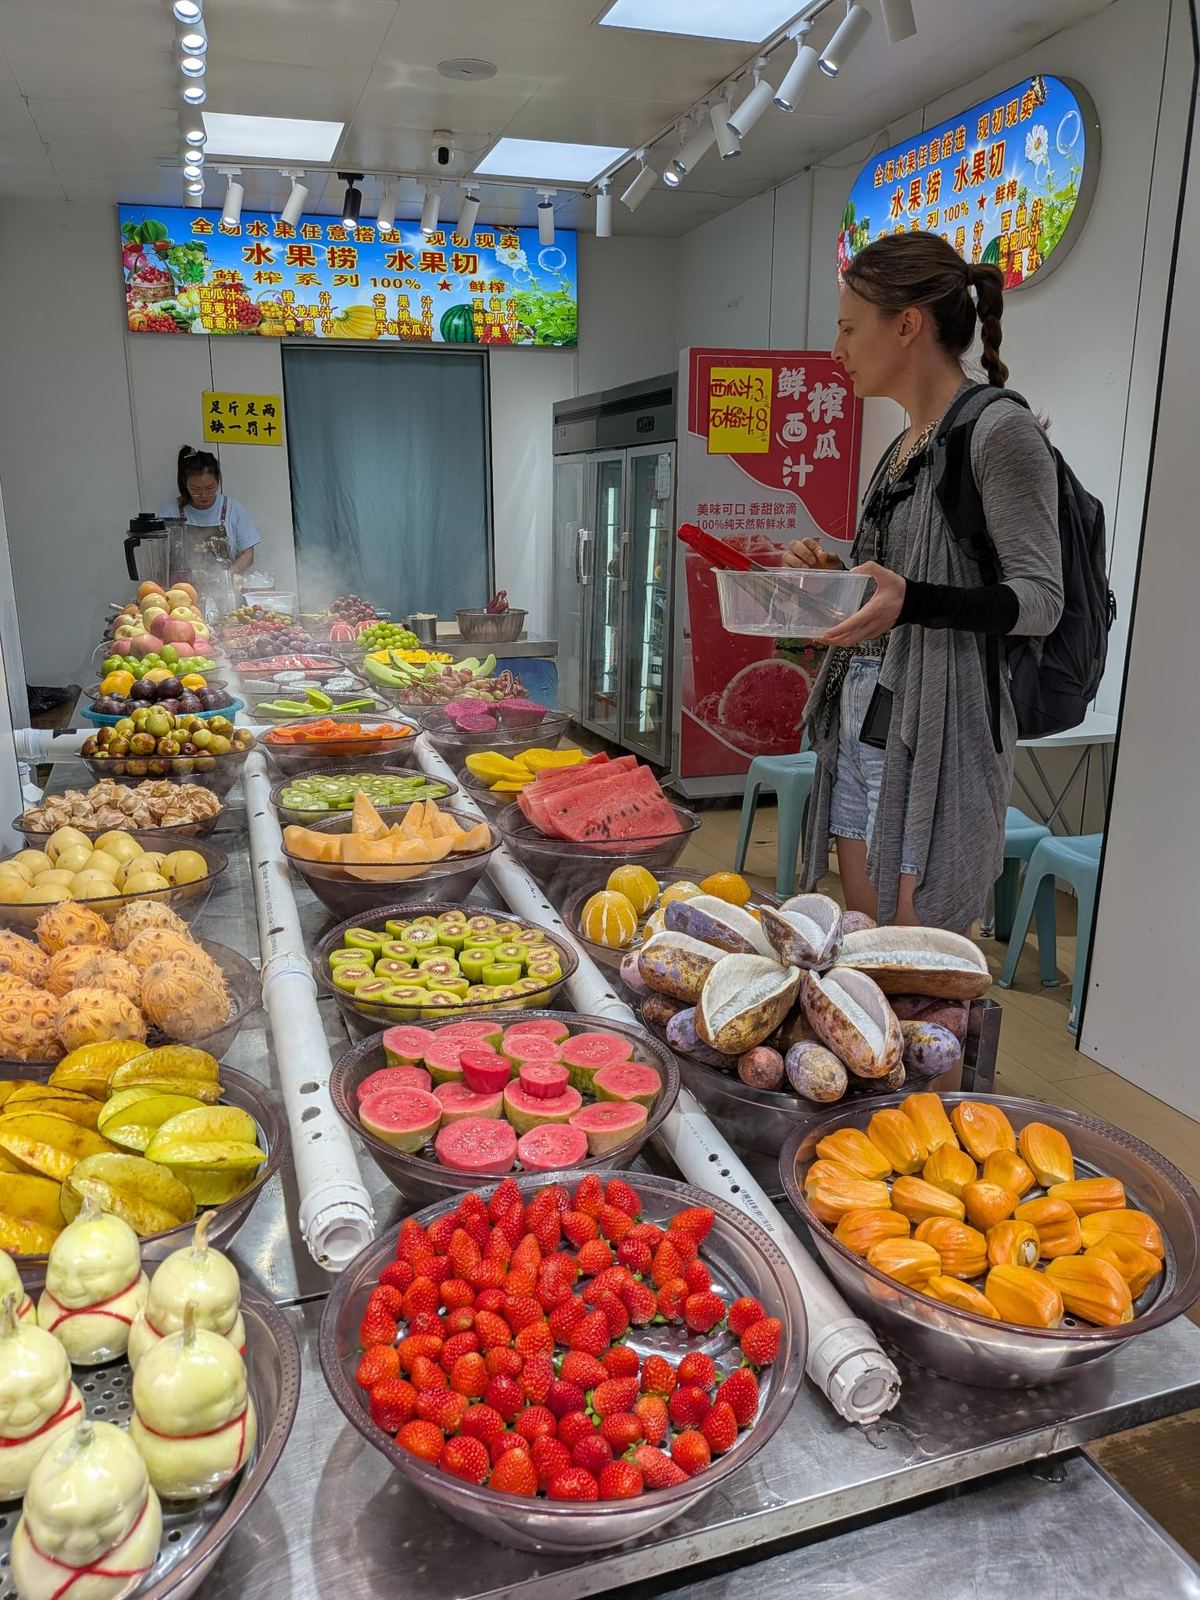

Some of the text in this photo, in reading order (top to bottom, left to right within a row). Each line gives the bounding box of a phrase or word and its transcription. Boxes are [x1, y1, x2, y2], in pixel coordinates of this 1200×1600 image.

[977, 90, 1035, 141] 现切现卖
[890, 141, 1005, 218] 水果捞 水果切
[243, 242, 479, 274] 水果捞 水果切
[370, 278, 421, 290] 100%
[200, 287, 237, 301] 西瓜汁
[209, 400, 275, 417] 足斤足两
[209, 419, 276, 436] 缺一罚十
[697, 502, 797, 517] 美味可口 香甜欲滴
